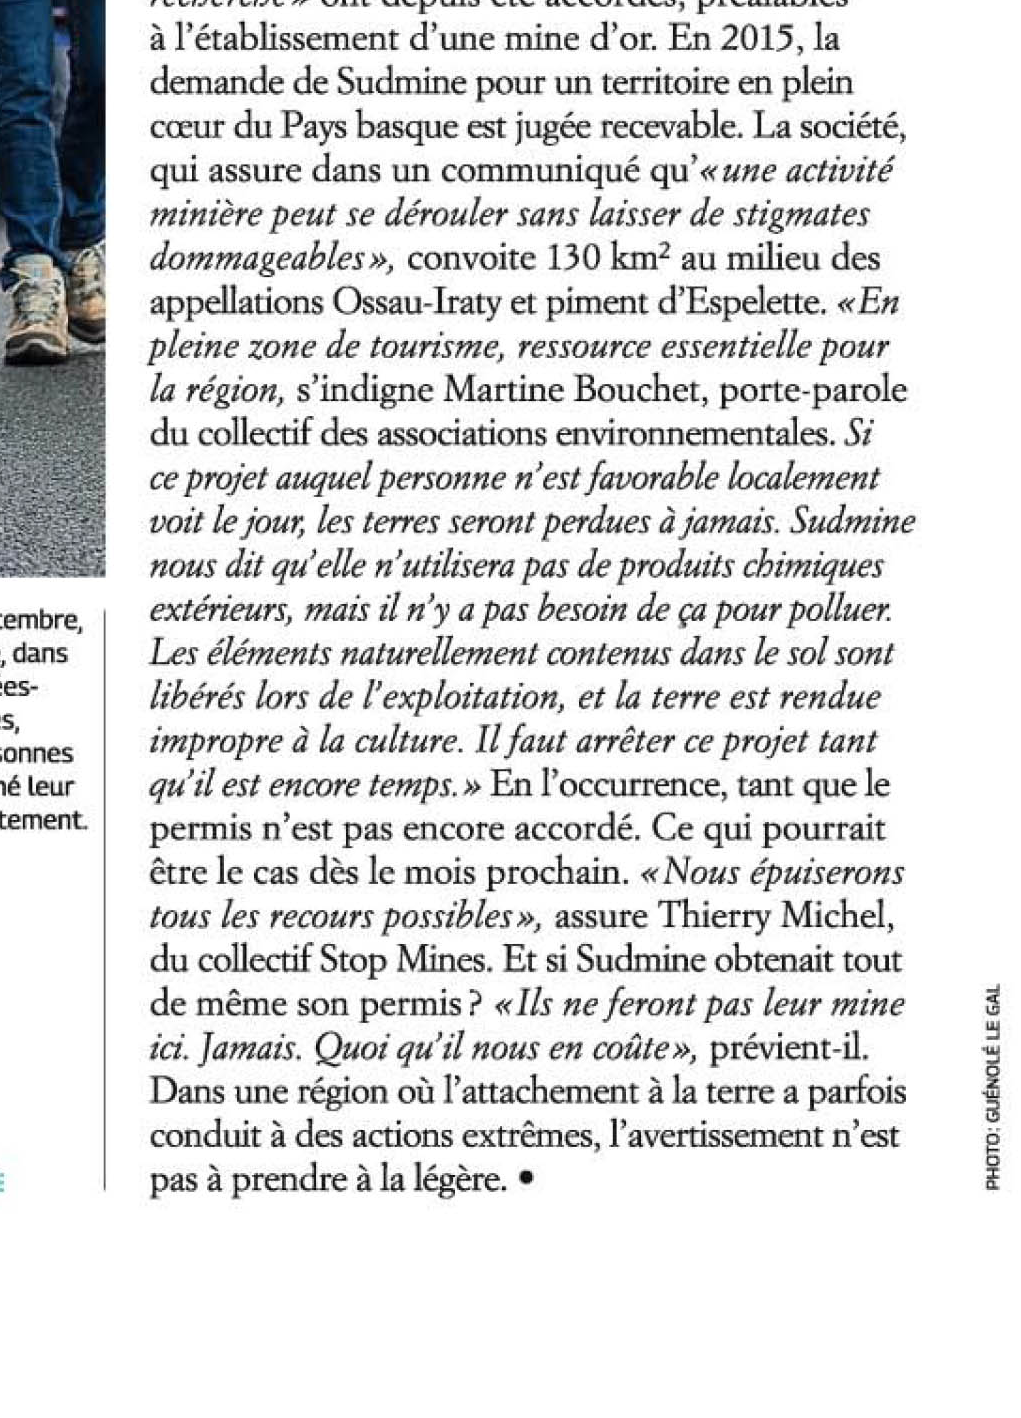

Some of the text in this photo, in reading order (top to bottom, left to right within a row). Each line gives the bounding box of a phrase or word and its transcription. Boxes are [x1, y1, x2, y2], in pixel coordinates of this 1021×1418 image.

[146, 327, 890, 367] pleine zone de tourisme, ressource essentielle pour
[149, 459, 881, 498] ce projet auquel personne n'est favorable localement
[12, 641, 69, 663] dans
[27, 774, 75, 797] leur
[149, 810, 887, 849] permis n'est pas encore accordé. Ce qui pourrait
[981, 983, 1001, 1191] PHOTO: GUÉNOLÉ LE GAL
[150, 1117, 900, 1153] conduit à des actions extrêmes, l'avertissement n'est
